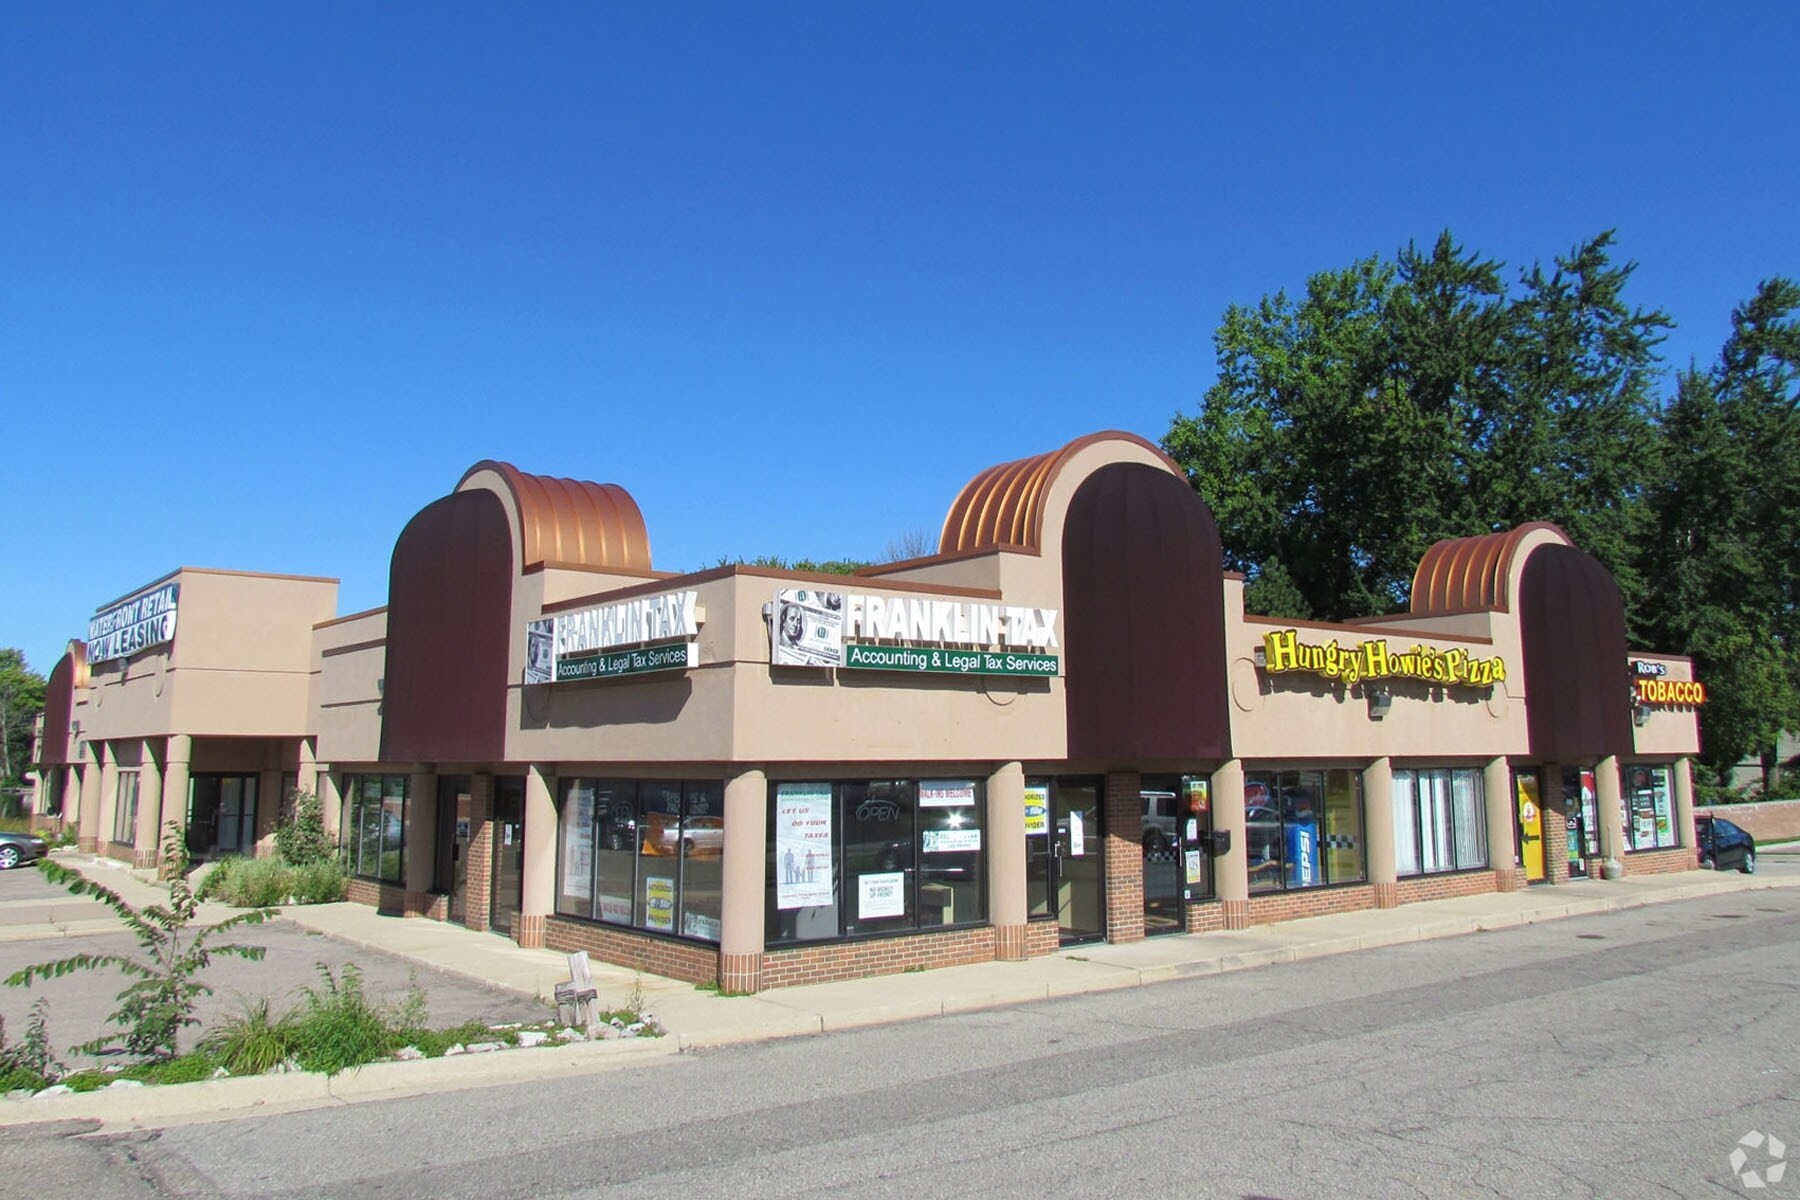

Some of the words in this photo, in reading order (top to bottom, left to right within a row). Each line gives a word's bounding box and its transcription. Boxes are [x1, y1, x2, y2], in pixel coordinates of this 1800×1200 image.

[89, 600, 141, 640] WATERFRONT
[140, 587, 176, 618] RETAIL
[557, 600, 647, 654] FRANKLIN
[648, 591, 697, 639] TAX
[846, 594, 1002, 645] FRANKLIN
[1004, 606, 1058, 648] TAX
[88, 640, 110, 662] NOW
[113, 616, 168, 653] LEASING
[1264, 629, 1363, 684] Hungry
[1361, 639, 1443, 680] Howie's
[1443, 647, 1506, 686] Pizza
[557, 658, 597, 678] Accounting
[599, 657, 607, 672] &
[608, 655, 631, 674] Legal
[631, 652, 647, 668] Tax
[648, 648, 687, 666] Services
[850, 648, 927, 670] Accounting
[931, 652, 941, 665] &
[945, 652, 981, 672] Legal
[983, 656, 1002, 671] Tax
[1006, 656, 1057, 672] Services
[1636, 660, 1667, 675] ROB'S
[1637, 679, 1705, 703] TOBACCO
[858, 804, 899, 822] OPEN
